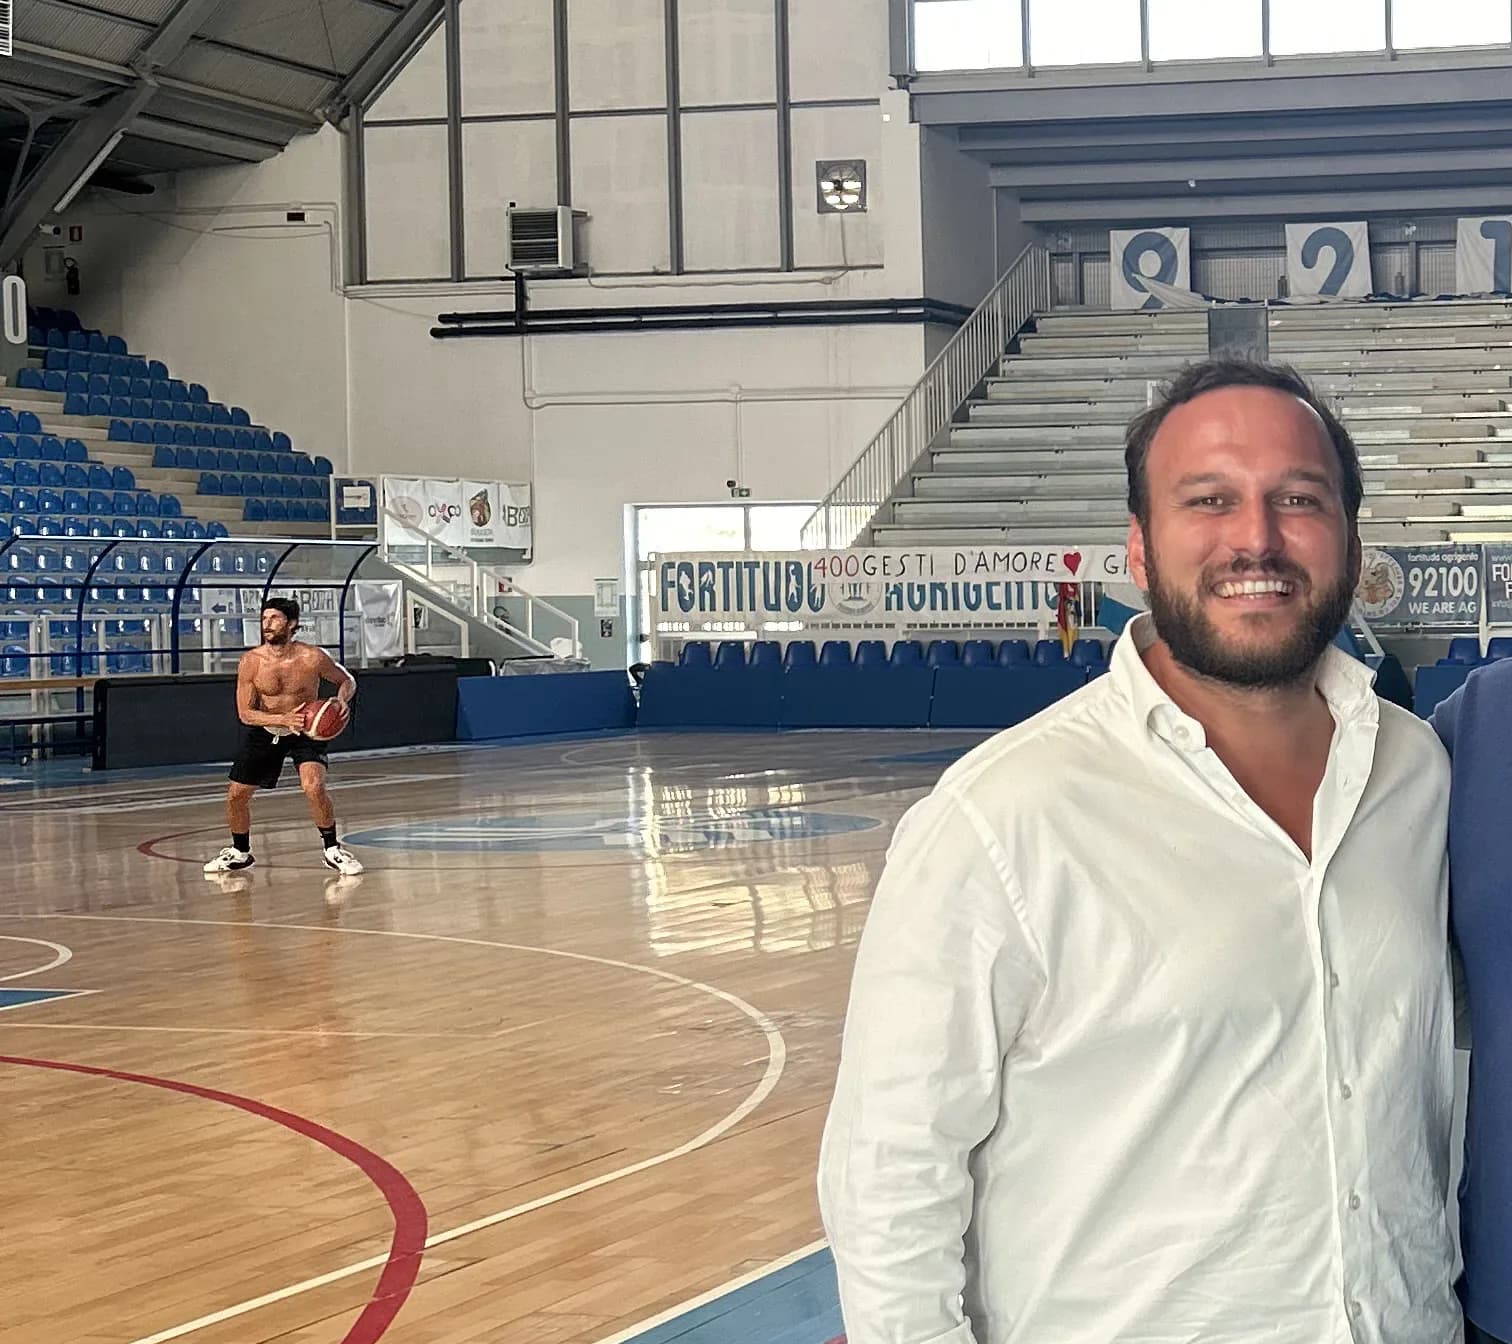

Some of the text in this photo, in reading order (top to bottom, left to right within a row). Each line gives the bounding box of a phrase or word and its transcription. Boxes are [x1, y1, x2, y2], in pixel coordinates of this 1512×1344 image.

[955, 551, 1058, 576] D'AMORE
[1408, 566, 1478, 597] 92100
[1408, 601, 1477, 614] WE ARE AG
